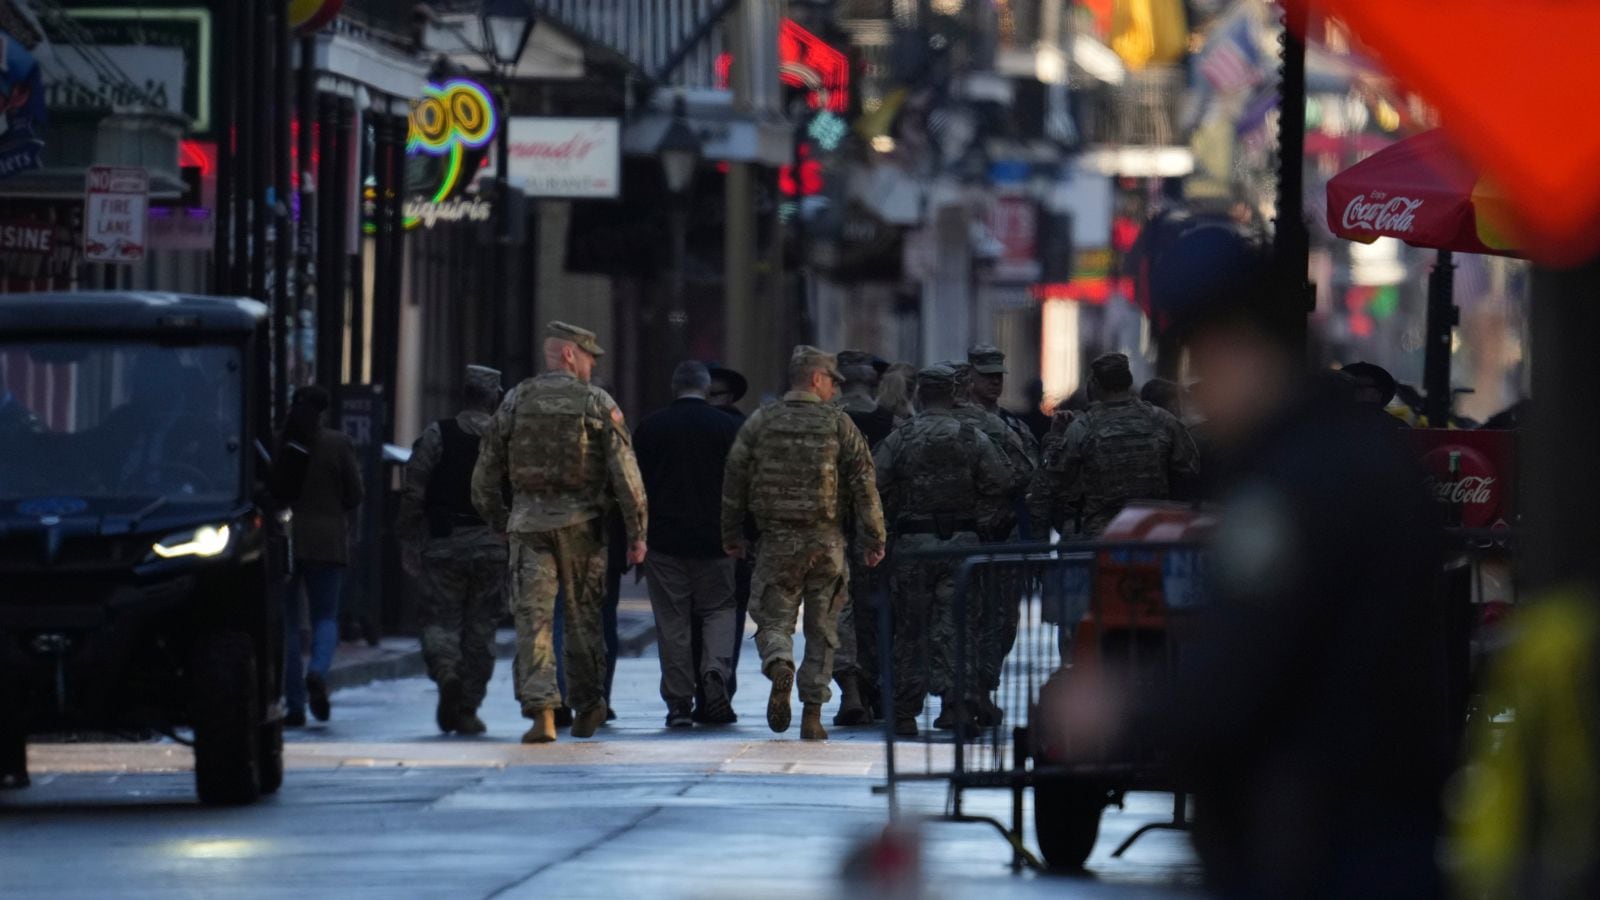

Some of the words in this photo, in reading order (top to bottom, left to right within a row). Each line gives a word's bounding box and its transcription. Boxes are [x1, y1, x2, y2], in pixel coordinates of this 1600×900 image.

[90, 171, 109, 189] NO
[100, 198, 130, 215] FIRE
[97, 220, 131, 235] LANE
